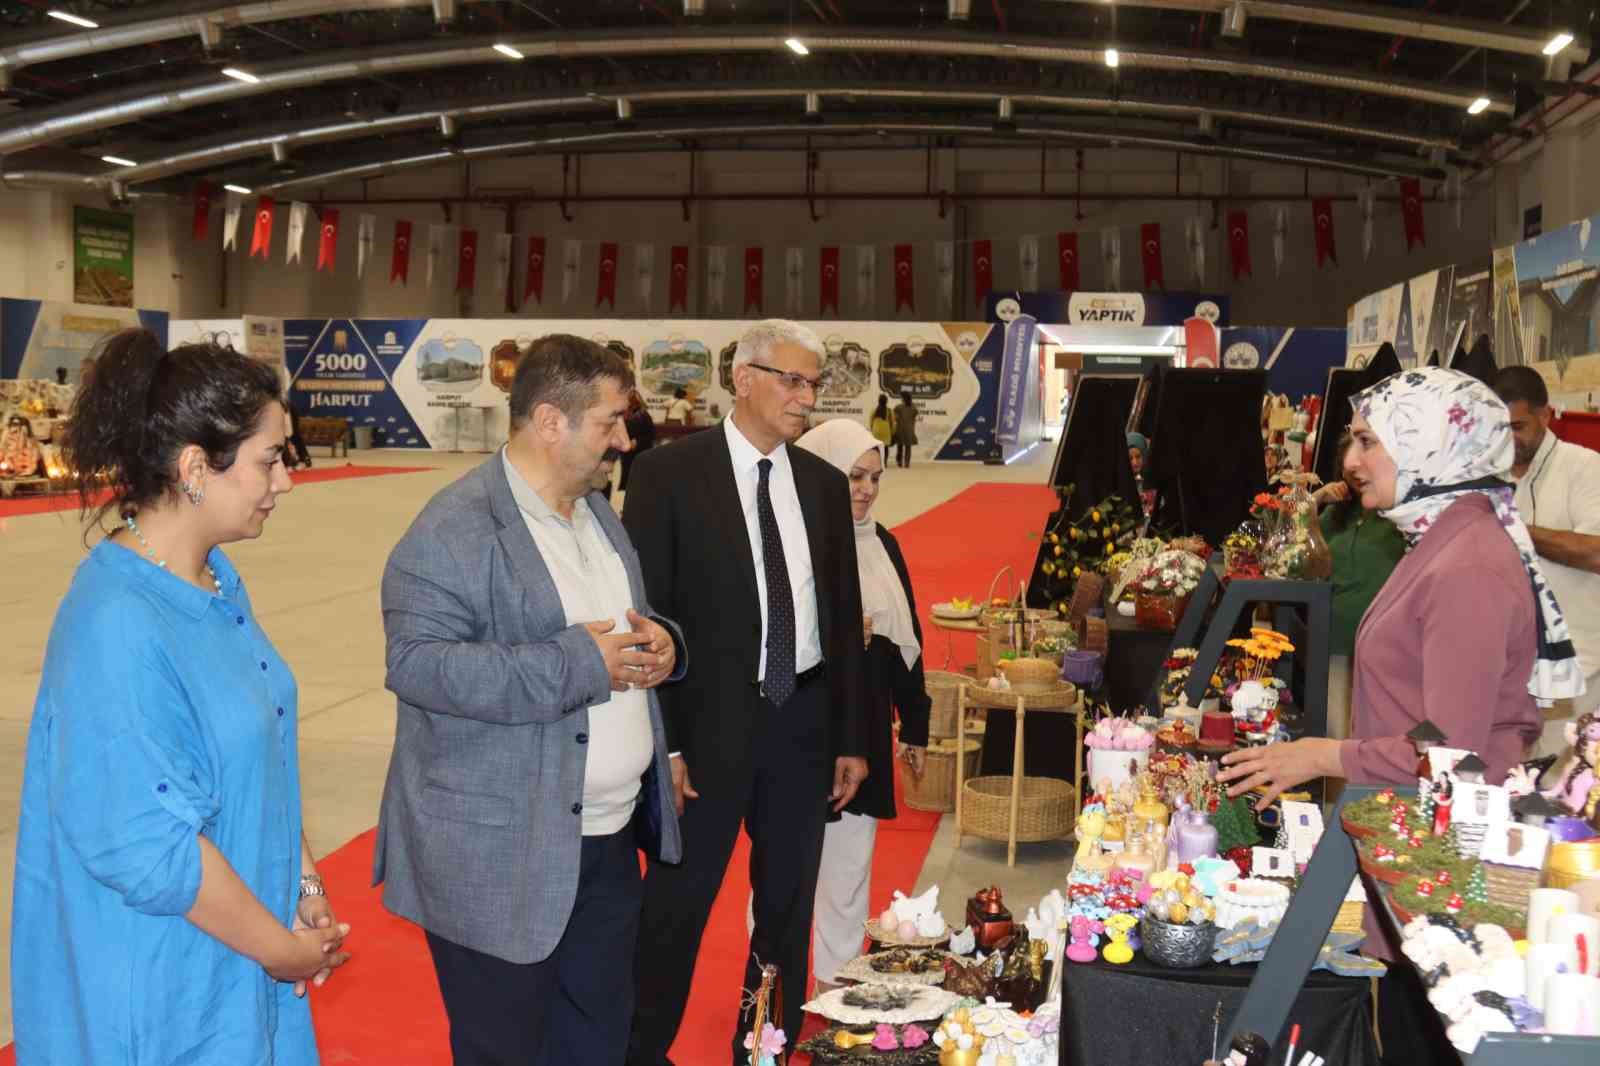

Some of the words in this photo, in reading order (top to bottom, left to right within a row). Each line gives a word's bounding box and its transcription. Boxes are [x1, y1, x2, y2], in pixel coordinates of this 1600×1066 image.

[1079, 309, 1136, 322] YAPTIK
[315, 353, 367, 371] 5000
[310, 393, 372, 408] HARPUT
